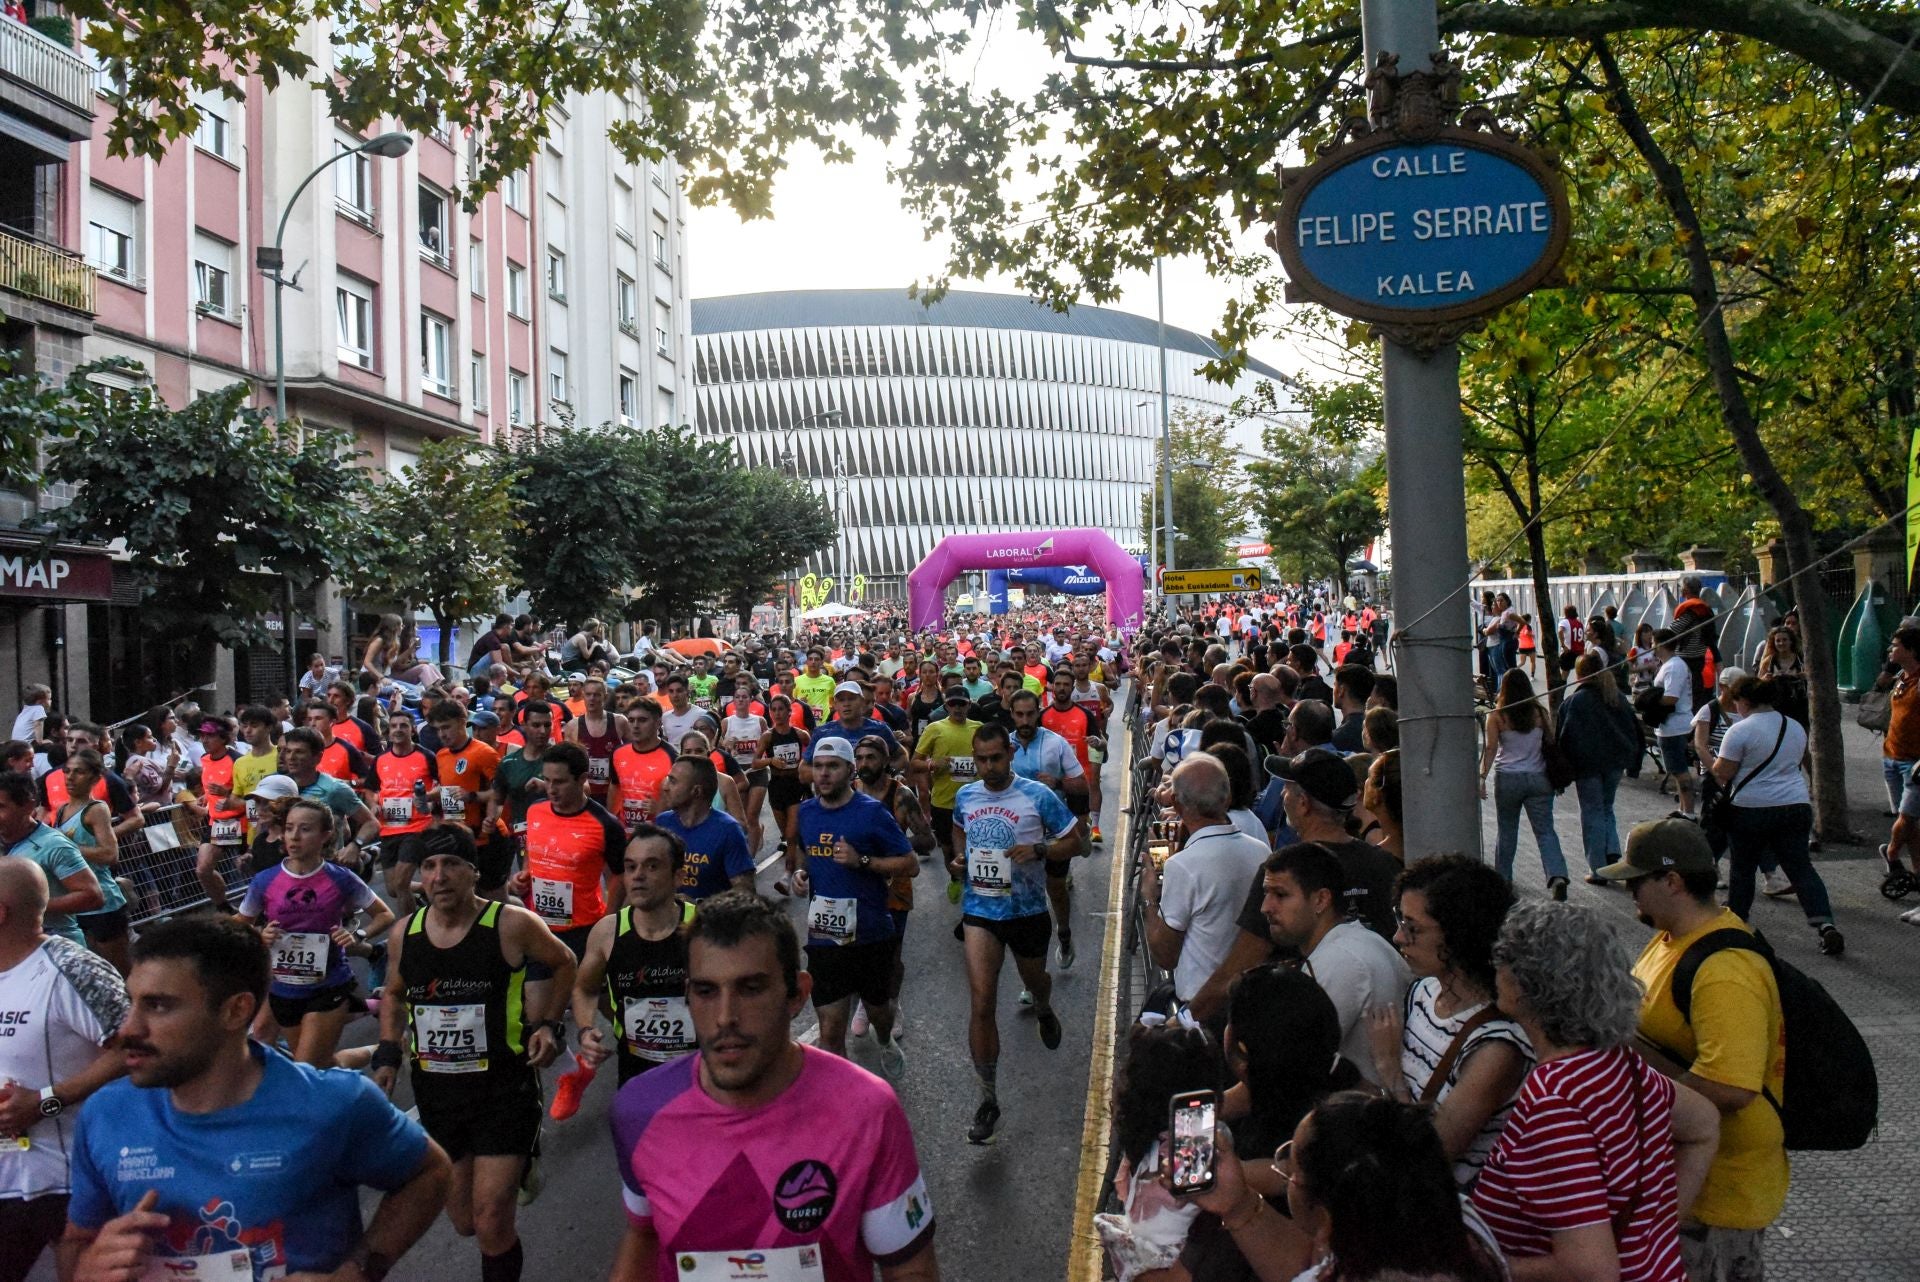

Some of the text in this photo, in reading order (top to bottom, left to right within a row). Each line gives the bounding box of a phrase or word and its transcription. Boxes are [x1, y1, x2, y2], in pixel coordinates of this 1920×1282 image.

[1371, 151, 1467, 178] CALLE
[1298, 201, 1548, 248] FELIPE SERRATE
[1377, 270, 1475, 296] KALEA
[986, 547, 1033, 559] LABORAL
[1572, 627, 1584, 642] 19
[954, 761, 975, 770] 1412
[386, 807, 407, 815] 2851
[819, 833, 834, 844] EZ
[976, 864, 999, 878] 119
[535, 893, 565, 908] 3386
[814, 912, 847, 927] 3520
[277, 949, 316, 965] 3613
[634, 1019, 684, 1036] 2492
[426, 1029, 475, 1047] 2775
